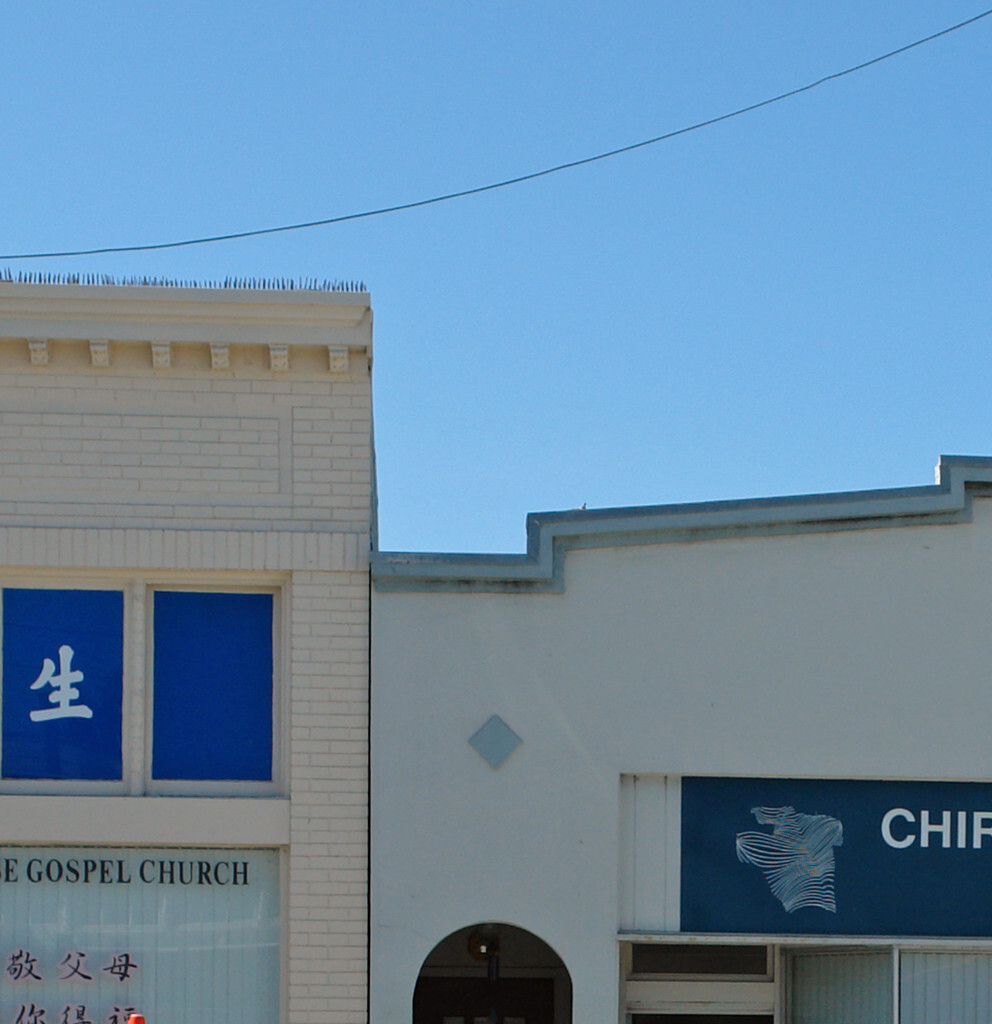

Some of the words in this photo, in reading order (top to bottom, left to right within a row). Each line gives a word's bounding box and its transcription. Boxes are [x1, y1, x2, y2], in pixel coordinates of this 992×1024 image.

[29, 645, 93, 722] 生
[26, 858, 131, 884] GOSPEL
[139, 859, 249, 885] CHURCH
